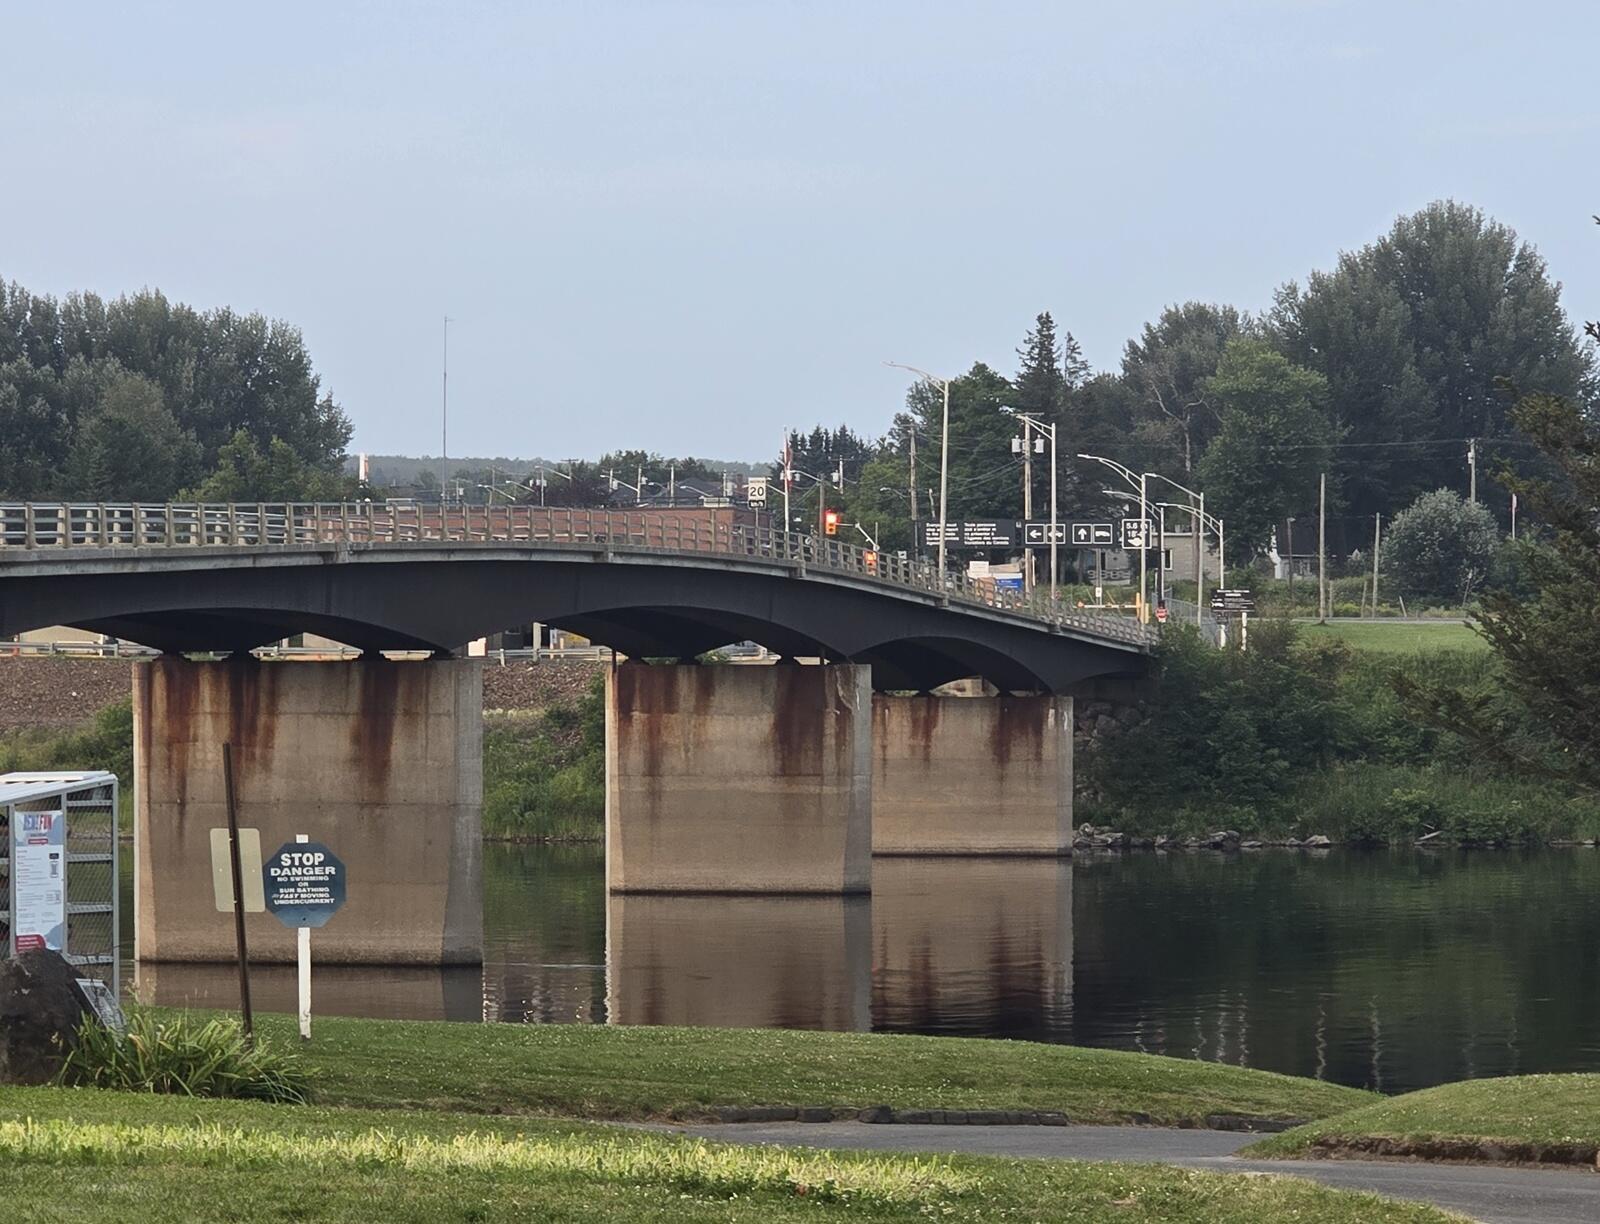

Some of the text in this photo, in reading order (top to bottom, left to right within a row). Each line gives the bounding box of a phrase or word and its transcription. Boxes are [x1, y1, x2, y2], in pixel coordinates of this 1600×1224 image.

[750, 487, 764, 496] 20
[280, 852, 324, 866] STOP
[270, 866, 336, 876] DANGER
